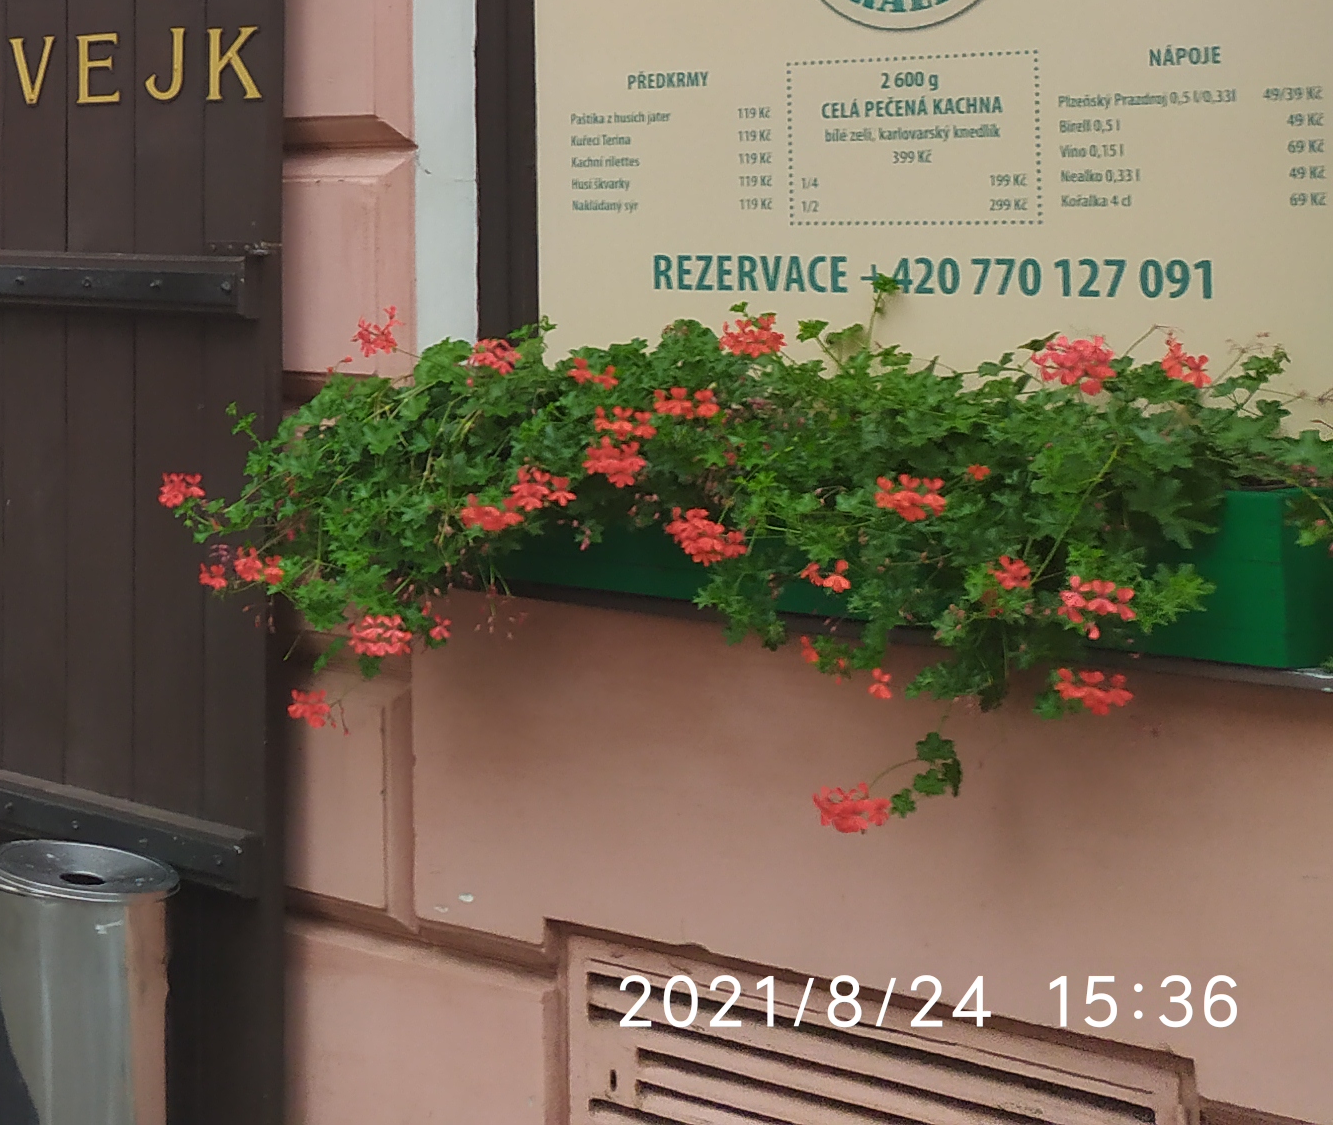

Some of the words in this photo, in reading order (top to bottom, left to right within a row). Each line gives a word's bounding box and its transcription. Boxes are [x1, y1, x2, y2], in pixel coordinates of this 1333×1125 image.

[1149, 44, 1222, 67] NÁPOJE
[627, 71, 709, 90] PŘEDKRMY
[880, 73, 890, 89] 2
[893, 72, 925, 88] 600
[929, 73, 940, 91] g
[737, 108, 757, 119] 119
[821, 98, 860, 119] CELÁ
[864, 95, 928, 118] PEČENÁ
[933, 95, 1004, 115] KACHNA
[738, 130, 757, 142] 119
[1287, 140, 1306, 154] 69
[738, 153, 757, 165] 119
[892, 151, 915, 164] 399
[738, 176, 758, 187] 119
[801, 177, 819, 189] 1/4
[989, 173, 1011, 187] 199
[739, 198, 758, 210] 119
[801, 200, 820, 213] 1/2
[989, 198, 1011, 212] 299
[1289, 193, 1308, 207] 69
[652, 254, 849, 294] REZERVACE
[860, 256, 960, 295] +420
[970, 258, 1042, 297] 770
[1053, 258, 1128, 298] 127
[1138, 259, 1214, 299] 091
